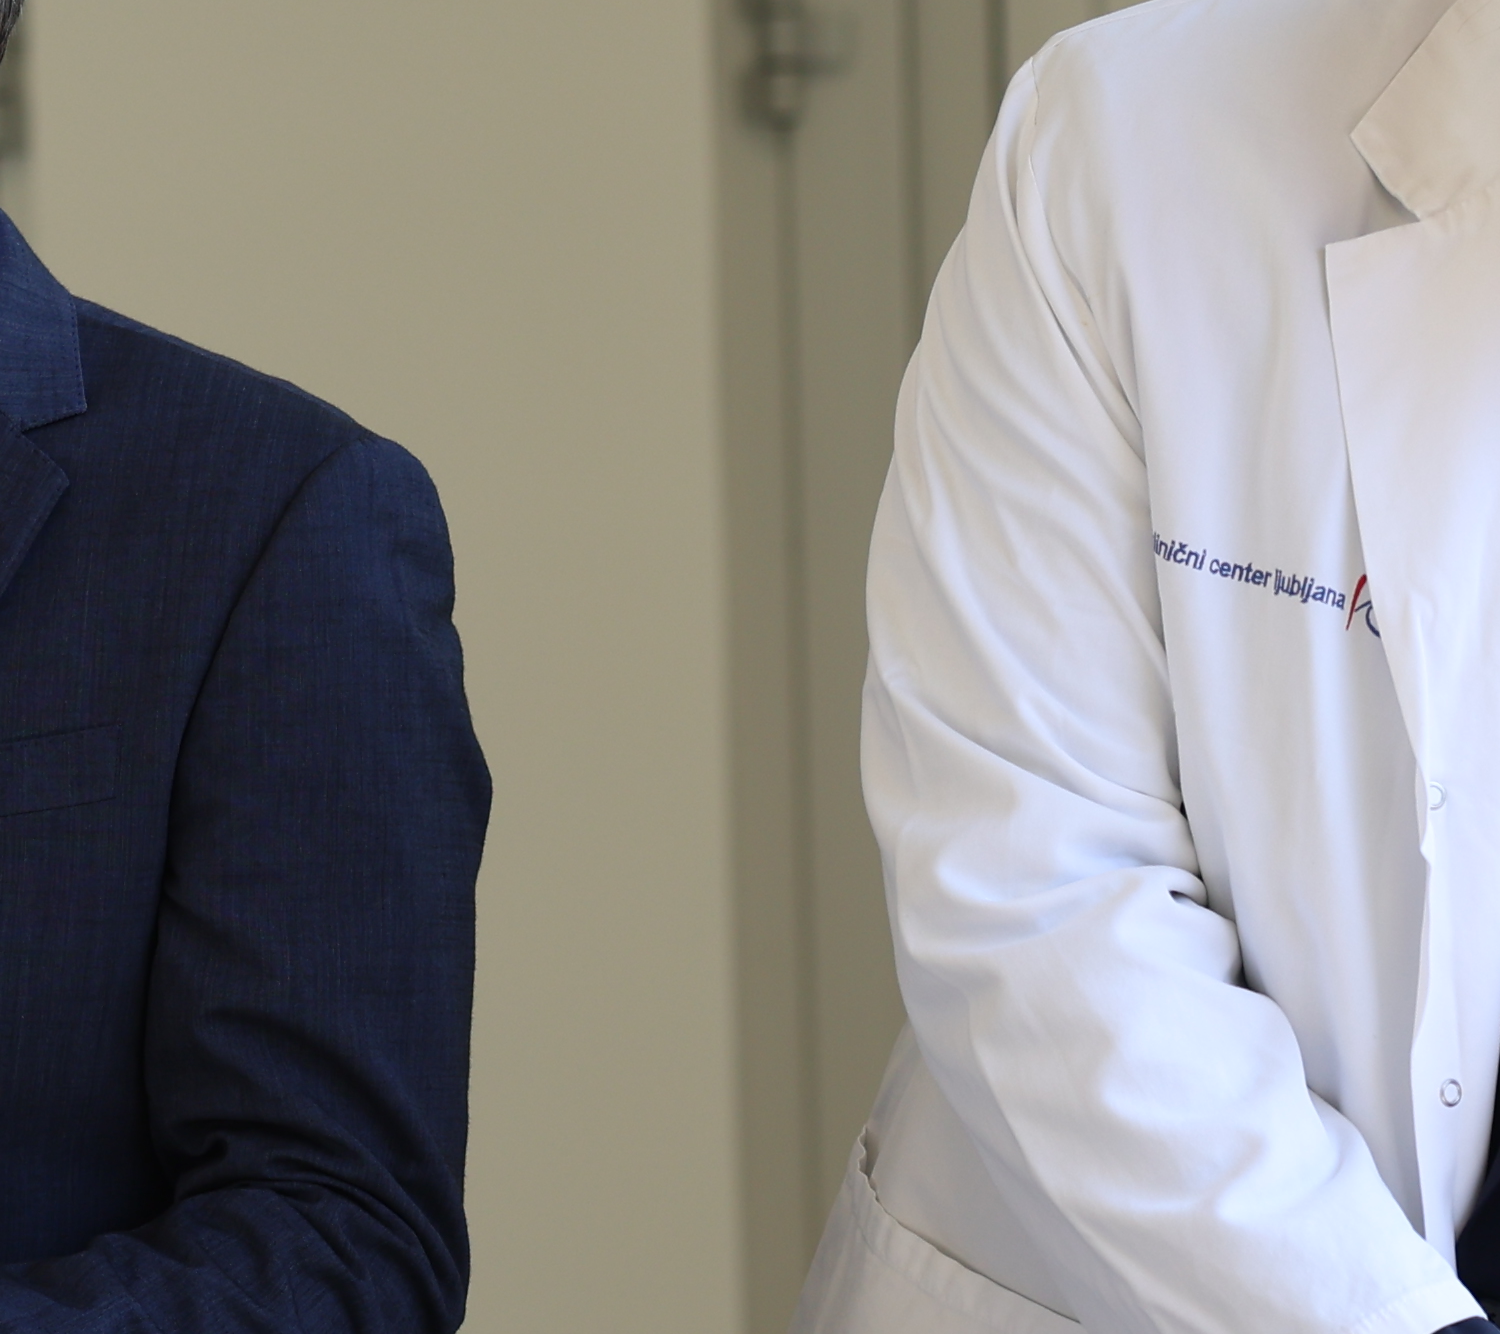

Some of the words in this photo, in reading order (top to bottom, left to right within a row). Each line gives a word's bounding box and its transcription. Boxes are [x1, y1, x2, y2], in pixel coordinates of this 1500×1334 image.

[1152, 531, 1207, 571] linični
[1209, 559, 1272, 588] center
[1274, 568, 1346, 610] ljubljana
